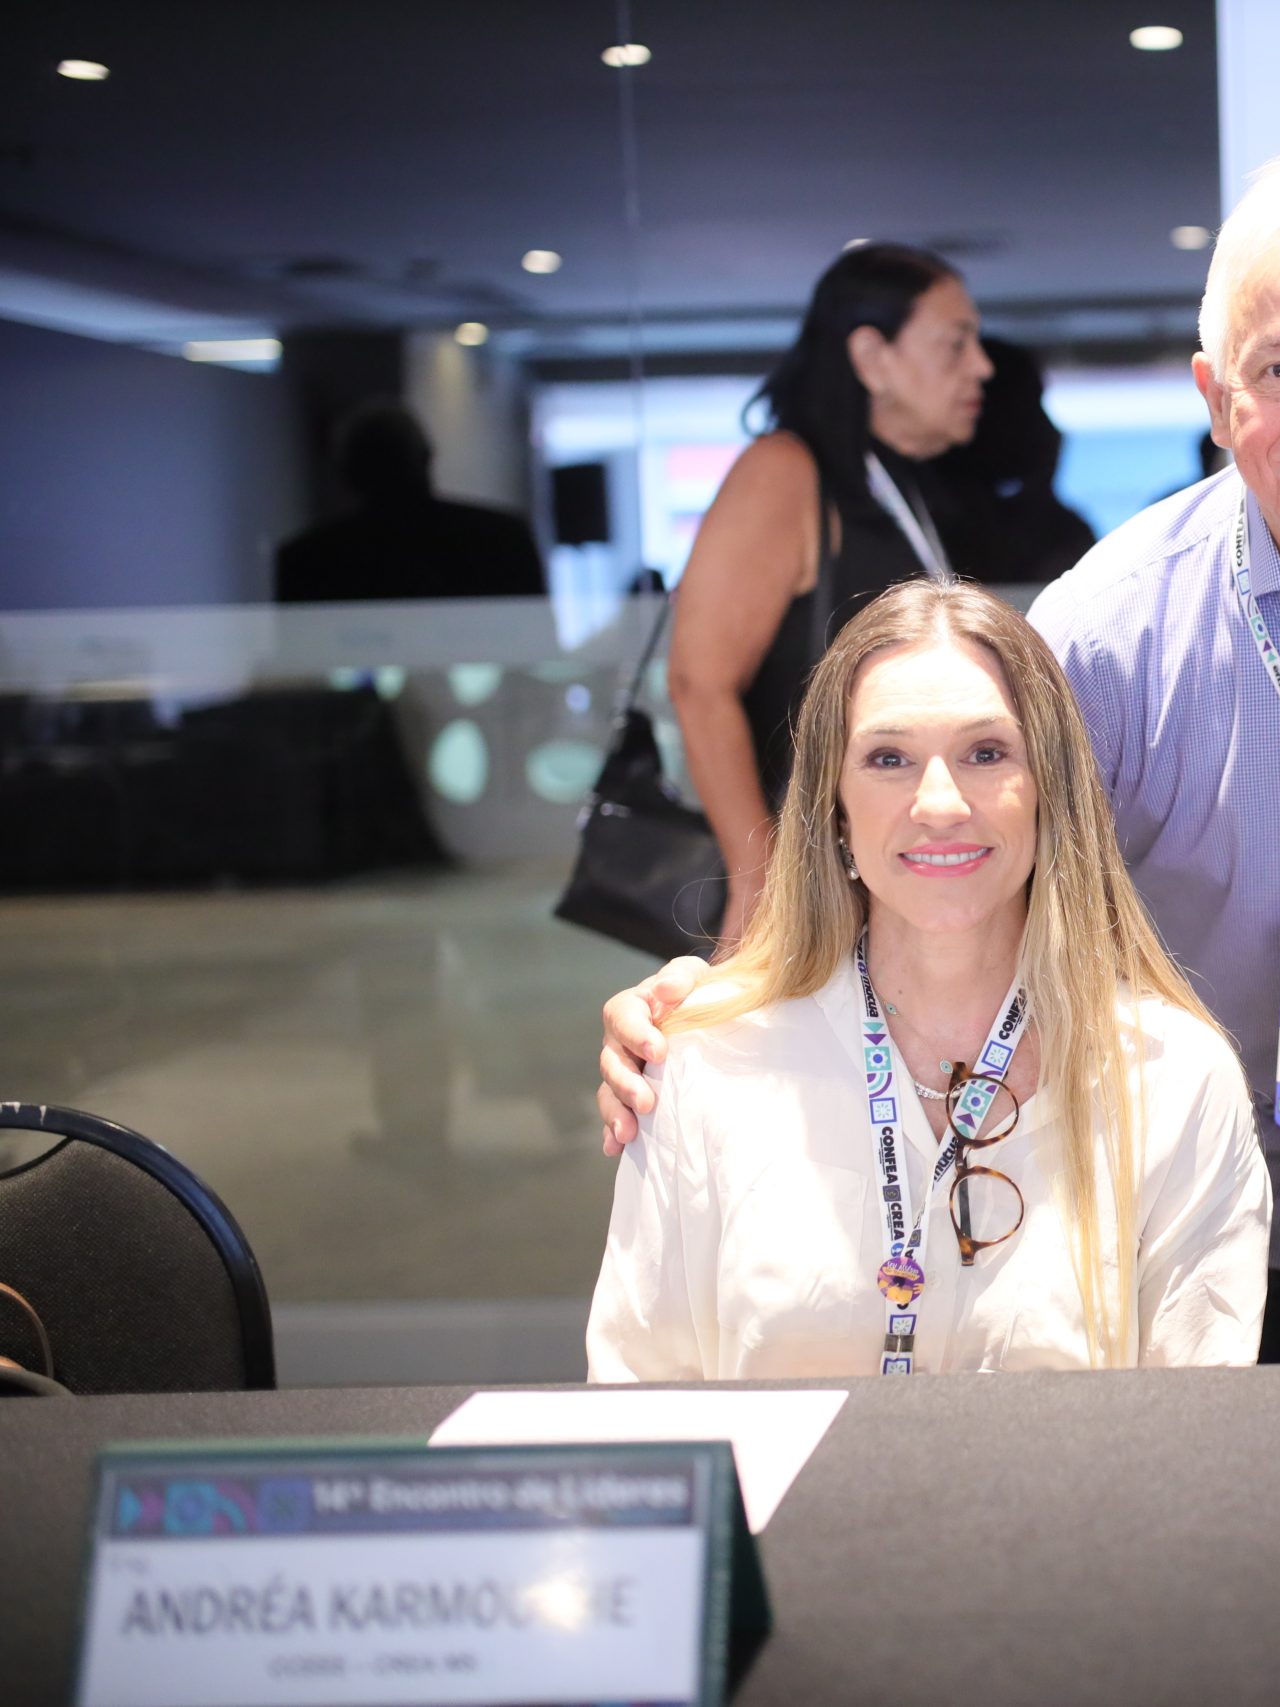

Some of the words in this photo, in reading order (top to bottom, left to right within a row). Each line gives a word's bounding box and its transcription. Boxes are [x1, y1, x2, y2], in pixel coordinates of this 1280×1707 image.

[882, 1126, 898, 1184] CONFEA
[890, 1202, 905, 1241] CREA
[121, 1571, 314, 1636] ANDRÉA
